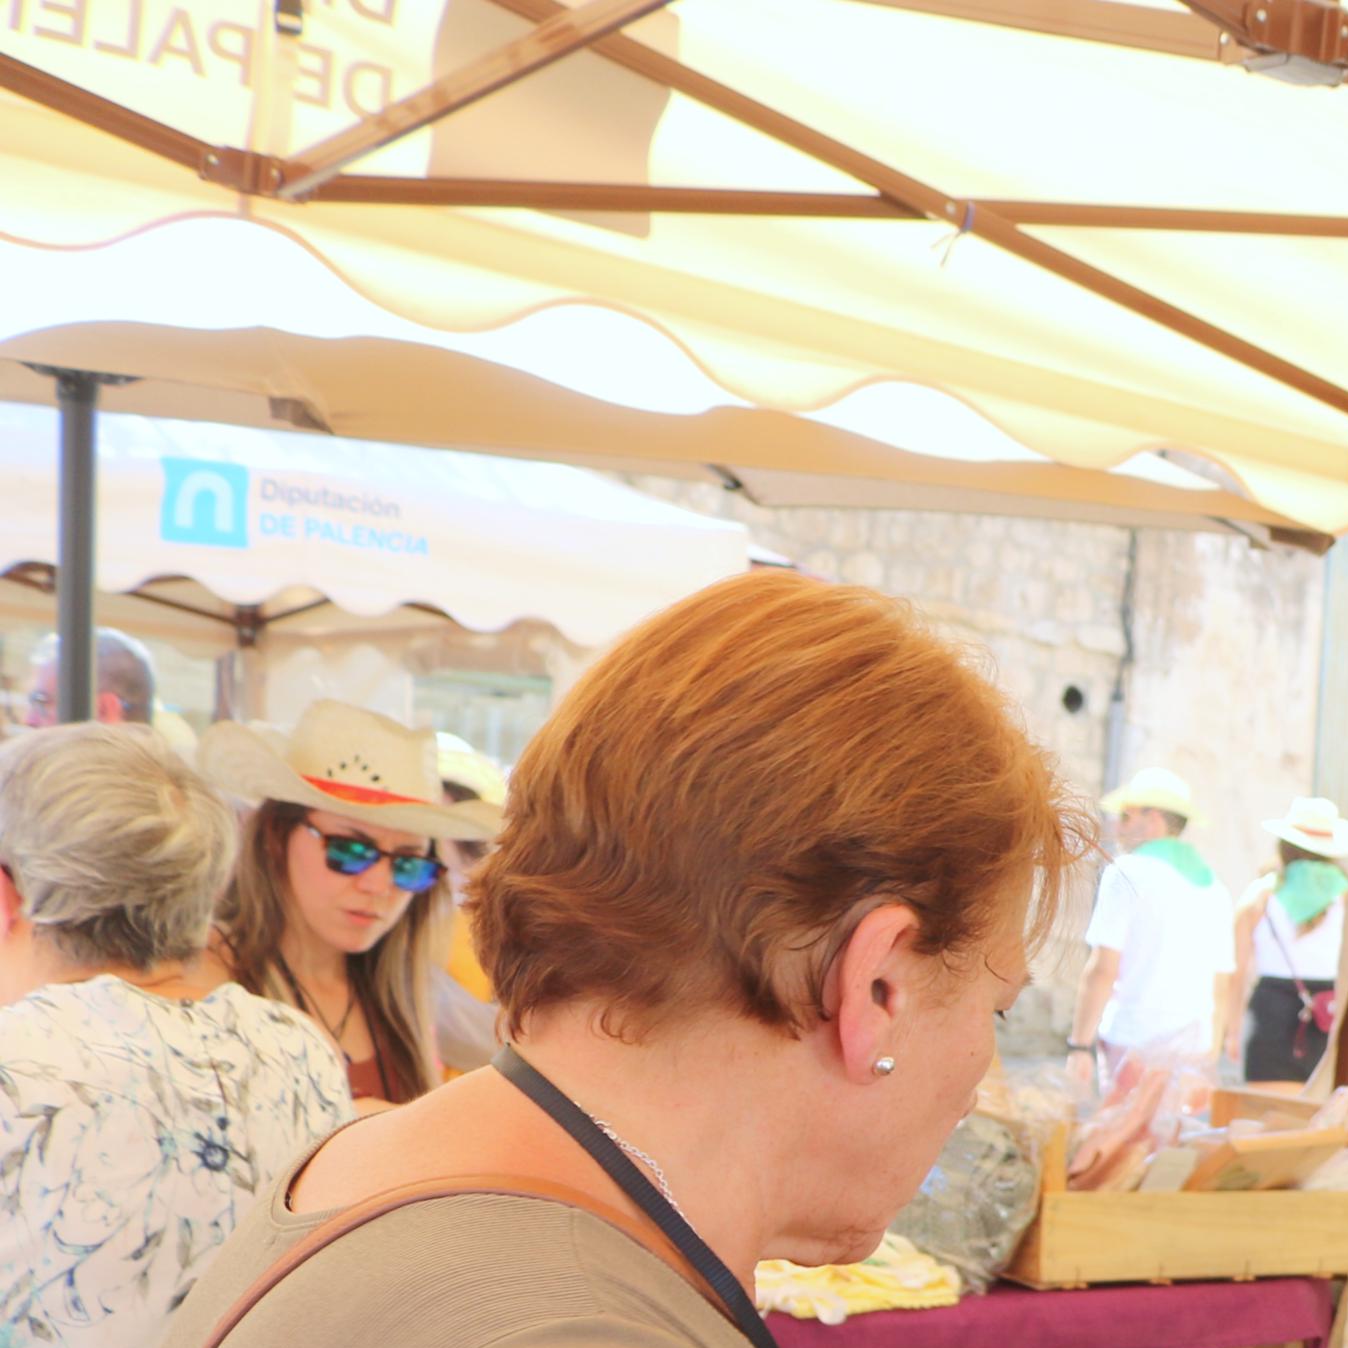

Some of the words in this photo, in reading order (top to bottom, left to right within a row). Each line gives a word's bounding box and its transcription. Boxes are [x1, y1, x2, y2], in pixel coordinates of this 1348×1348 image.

[260, 479, 401, 518] Diputación
[259, 513, 296, 538] DE
[304, 517, 430, 555] PALENCIA
